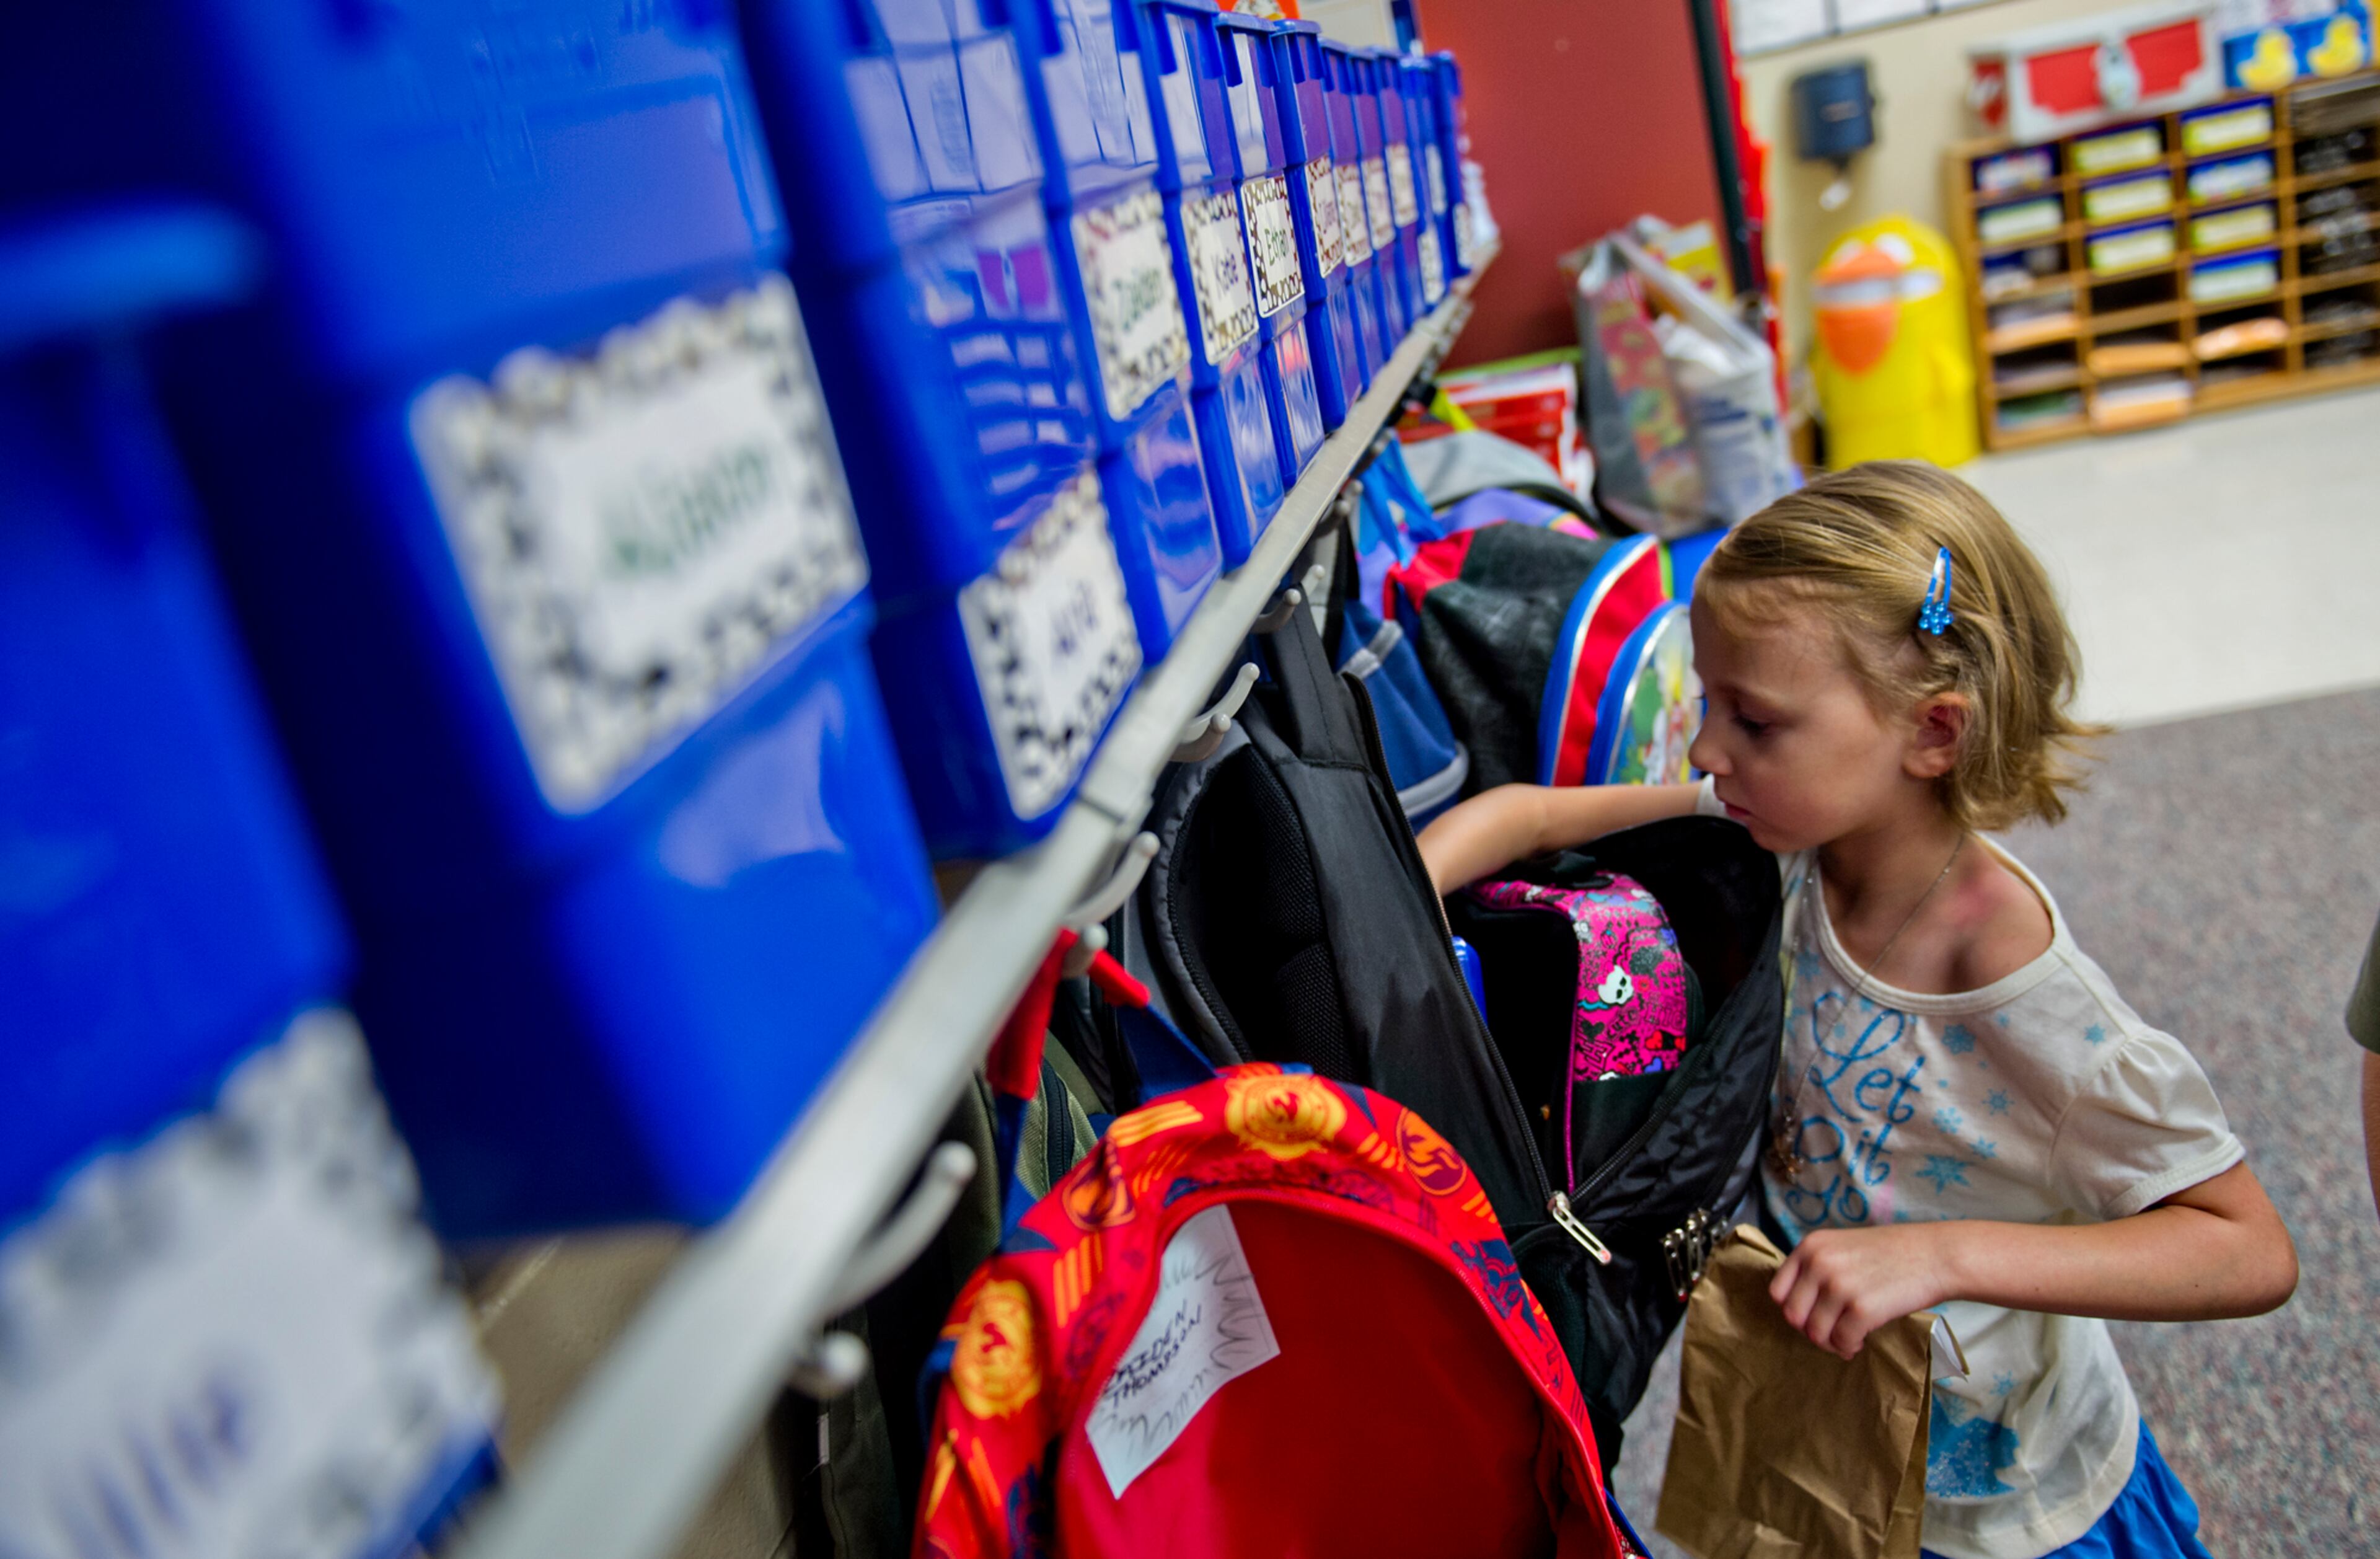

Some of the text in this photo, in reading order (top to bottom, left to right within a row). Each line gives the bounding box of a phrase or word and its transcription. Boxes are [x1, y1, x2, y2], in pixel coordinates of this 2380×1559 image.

[1807, 991, 1925, 1123] Let
[1848, 1123, 1893, 1186] it
[1113, 1304, 1202, 1408] THOMPSON
